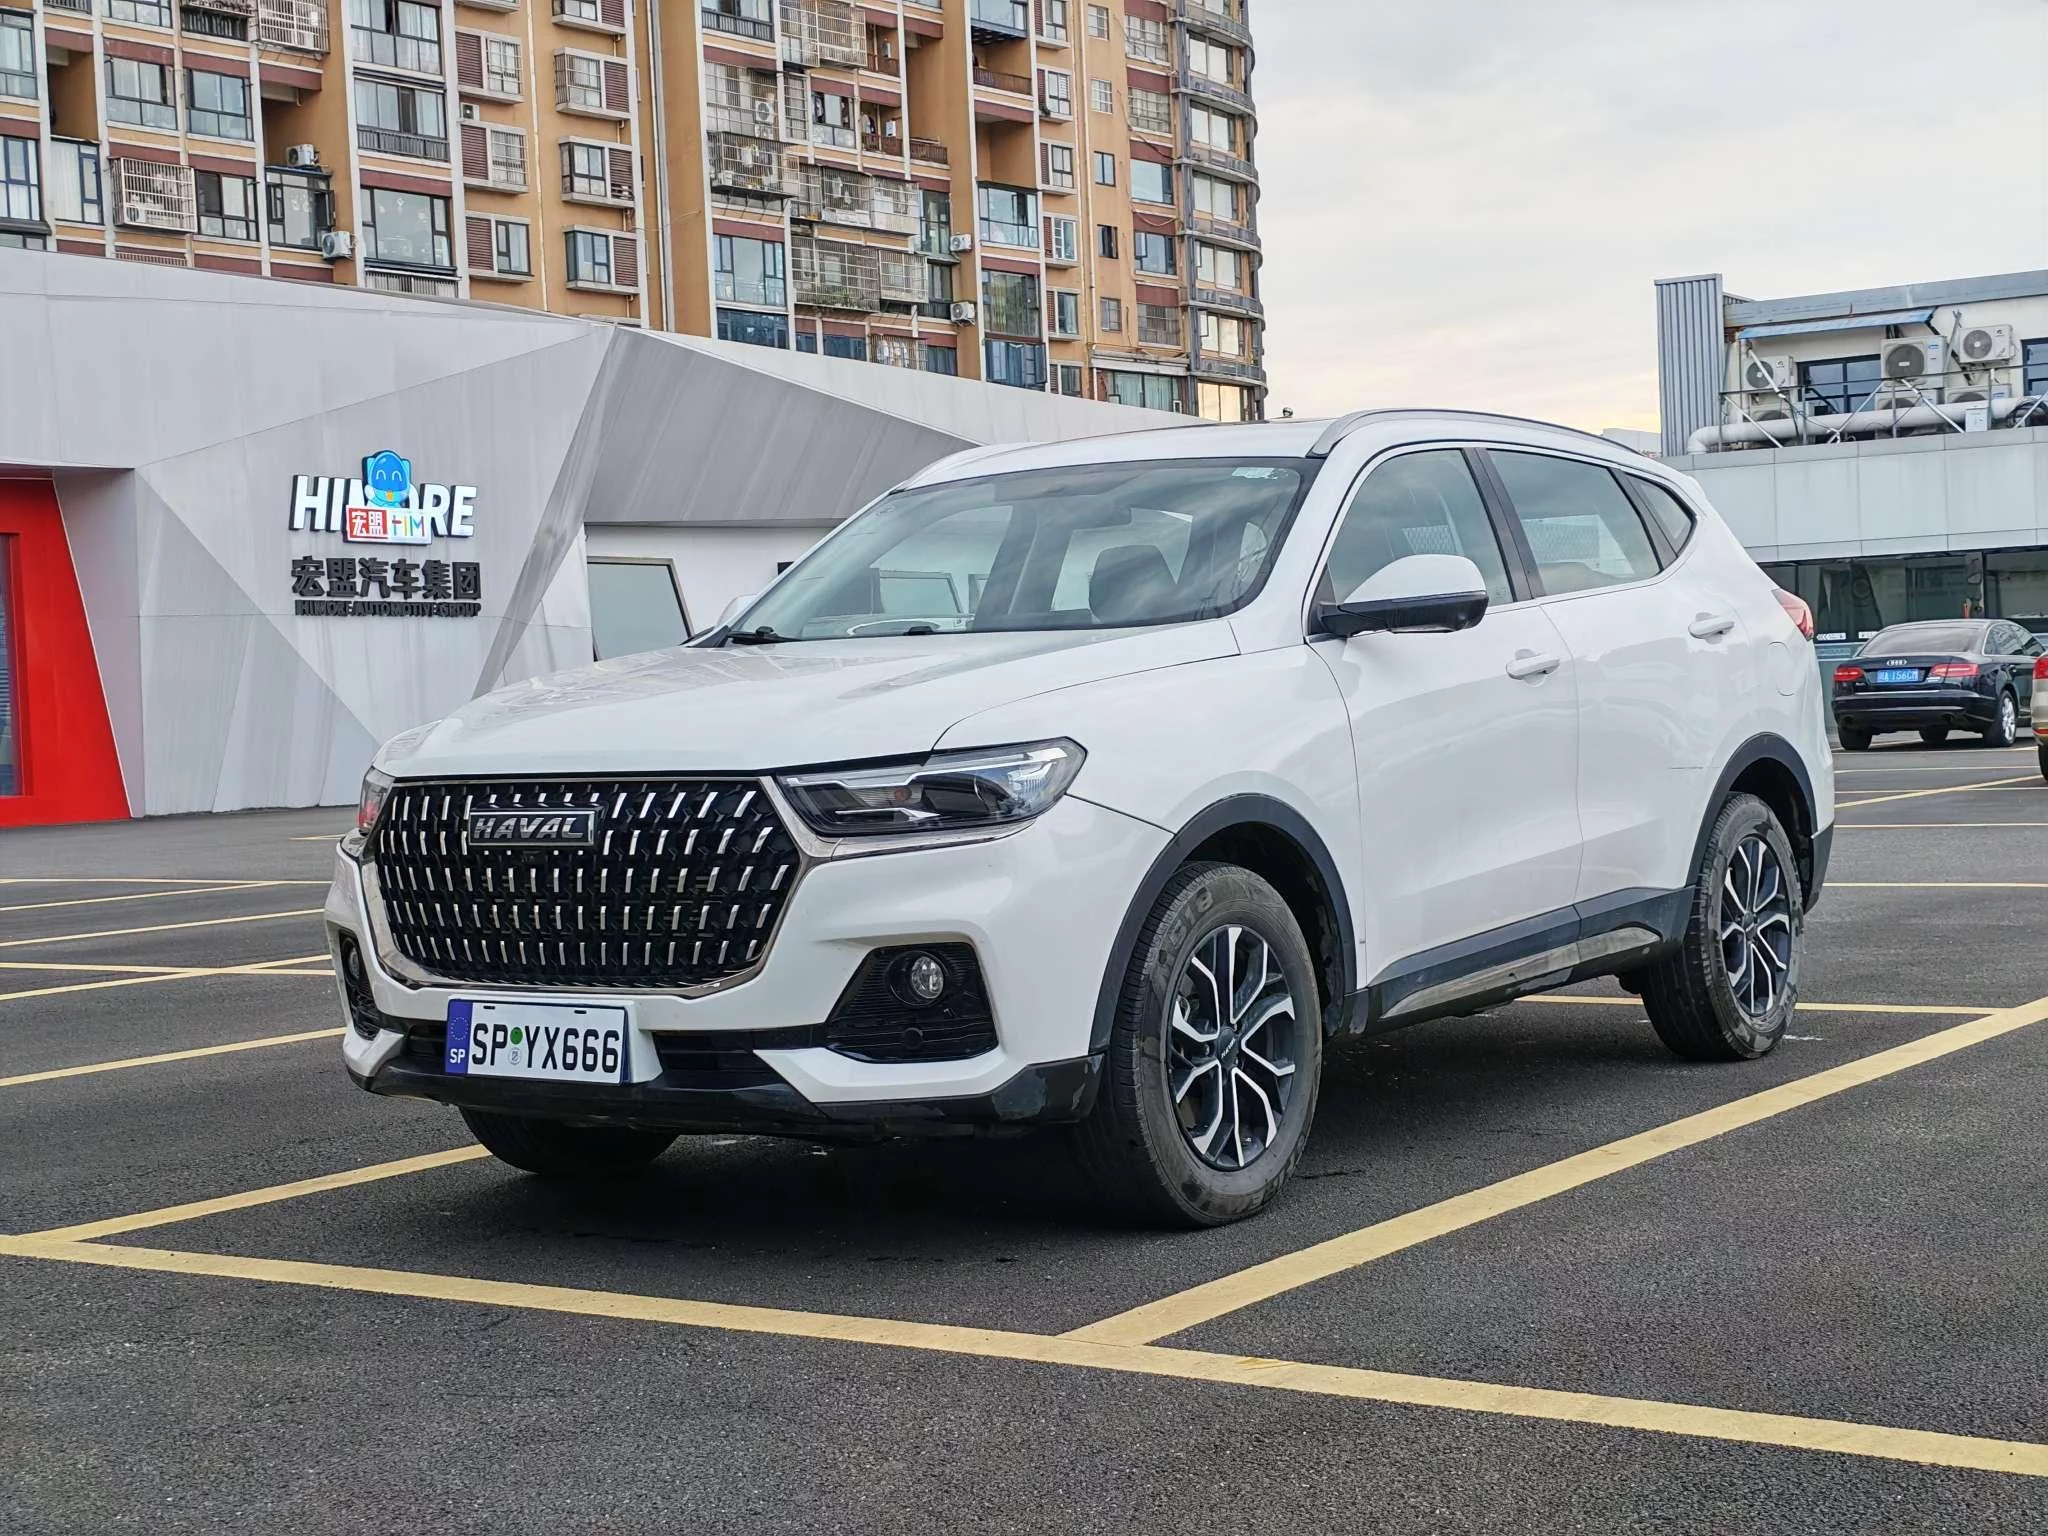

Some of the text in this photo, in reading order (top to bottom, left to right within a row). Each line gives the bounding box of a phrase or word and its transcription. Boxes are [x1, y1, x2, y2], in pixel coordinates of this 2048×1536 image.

[290, 475, 477, 537] HIRE
[351, 510, 384, 536] 宏盟
[291, 555, 482, 600] 宏盟汽车集团
[473, 817, 584, 840] HAVAL
[450, 1049, 465, 1062] SP
[471, 1023, 620, 1073] SP YX666
